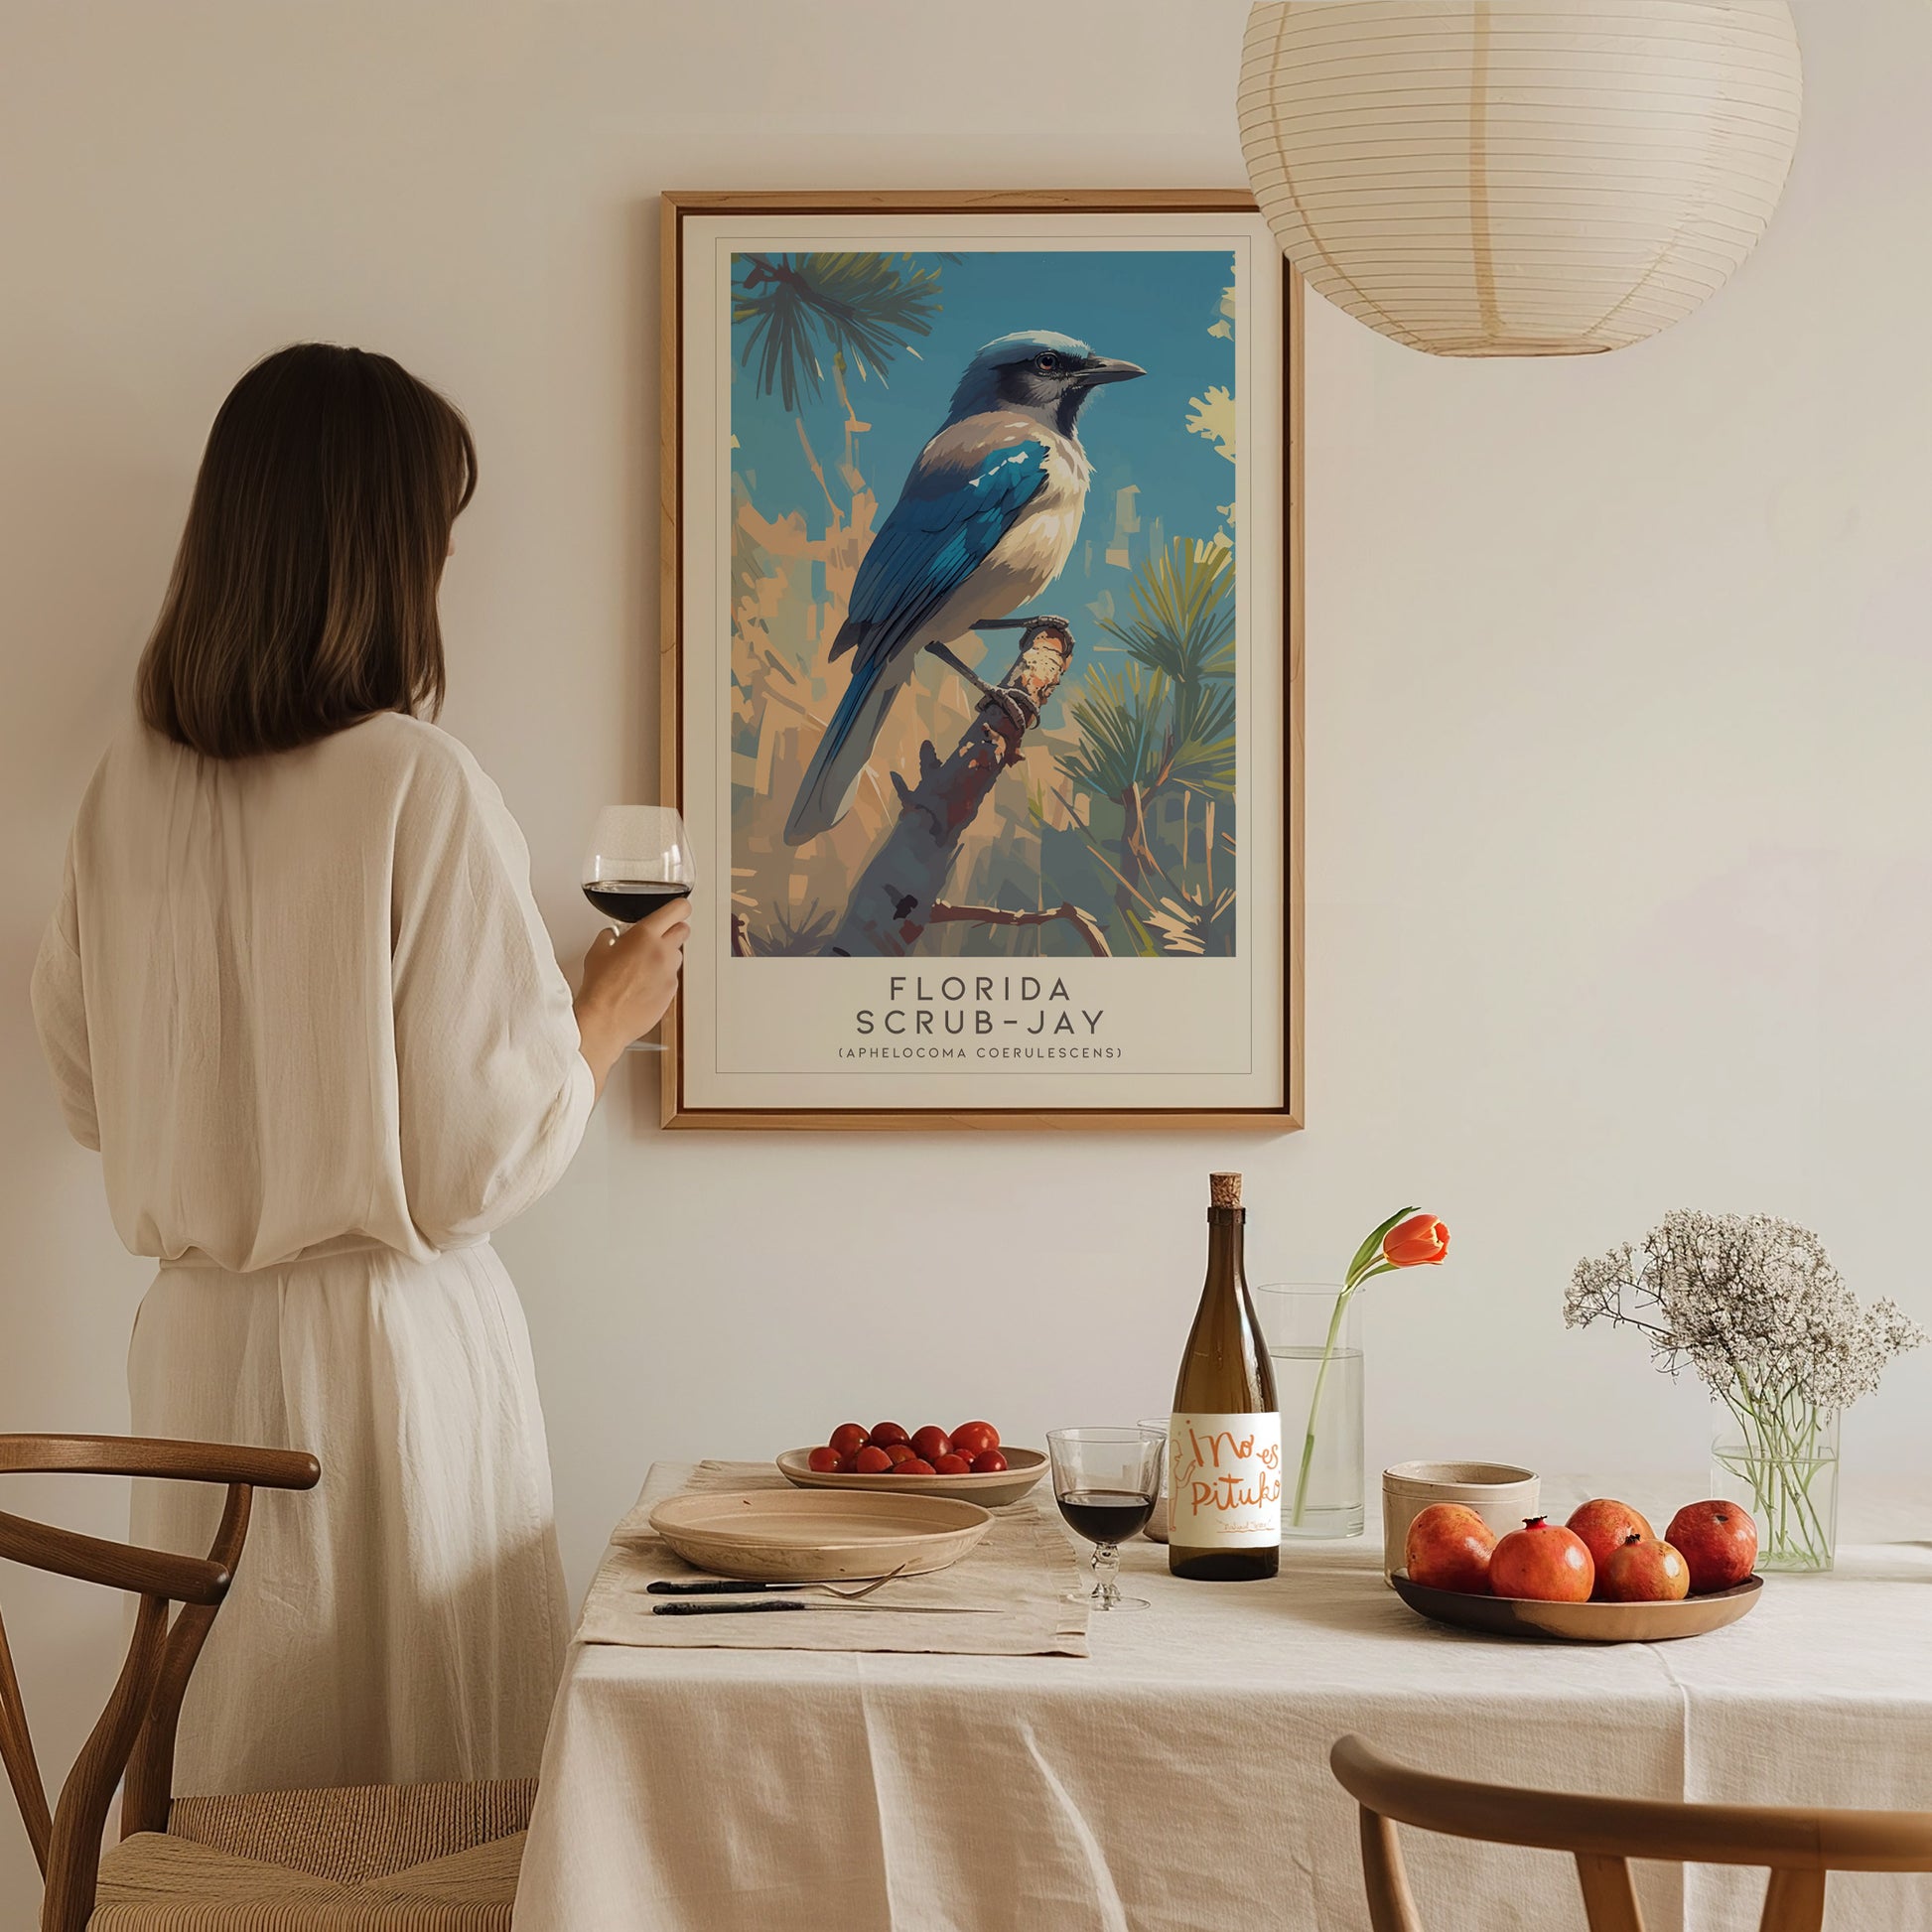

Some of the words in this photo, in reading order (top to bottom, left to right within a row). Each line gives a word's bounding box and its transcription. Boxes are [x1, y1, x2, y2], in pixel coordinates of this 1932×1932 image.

[890, 976, 1070, 1001] FLORIDA
[856, 1010, 1104, 1035] SCRUB-JAY
[838, 1046, 967, 1058] (APHELOCOMA
[976, 1046, 1122, 1058] COERULESCENS)
[1256, 1444, 1279, 1470] es
